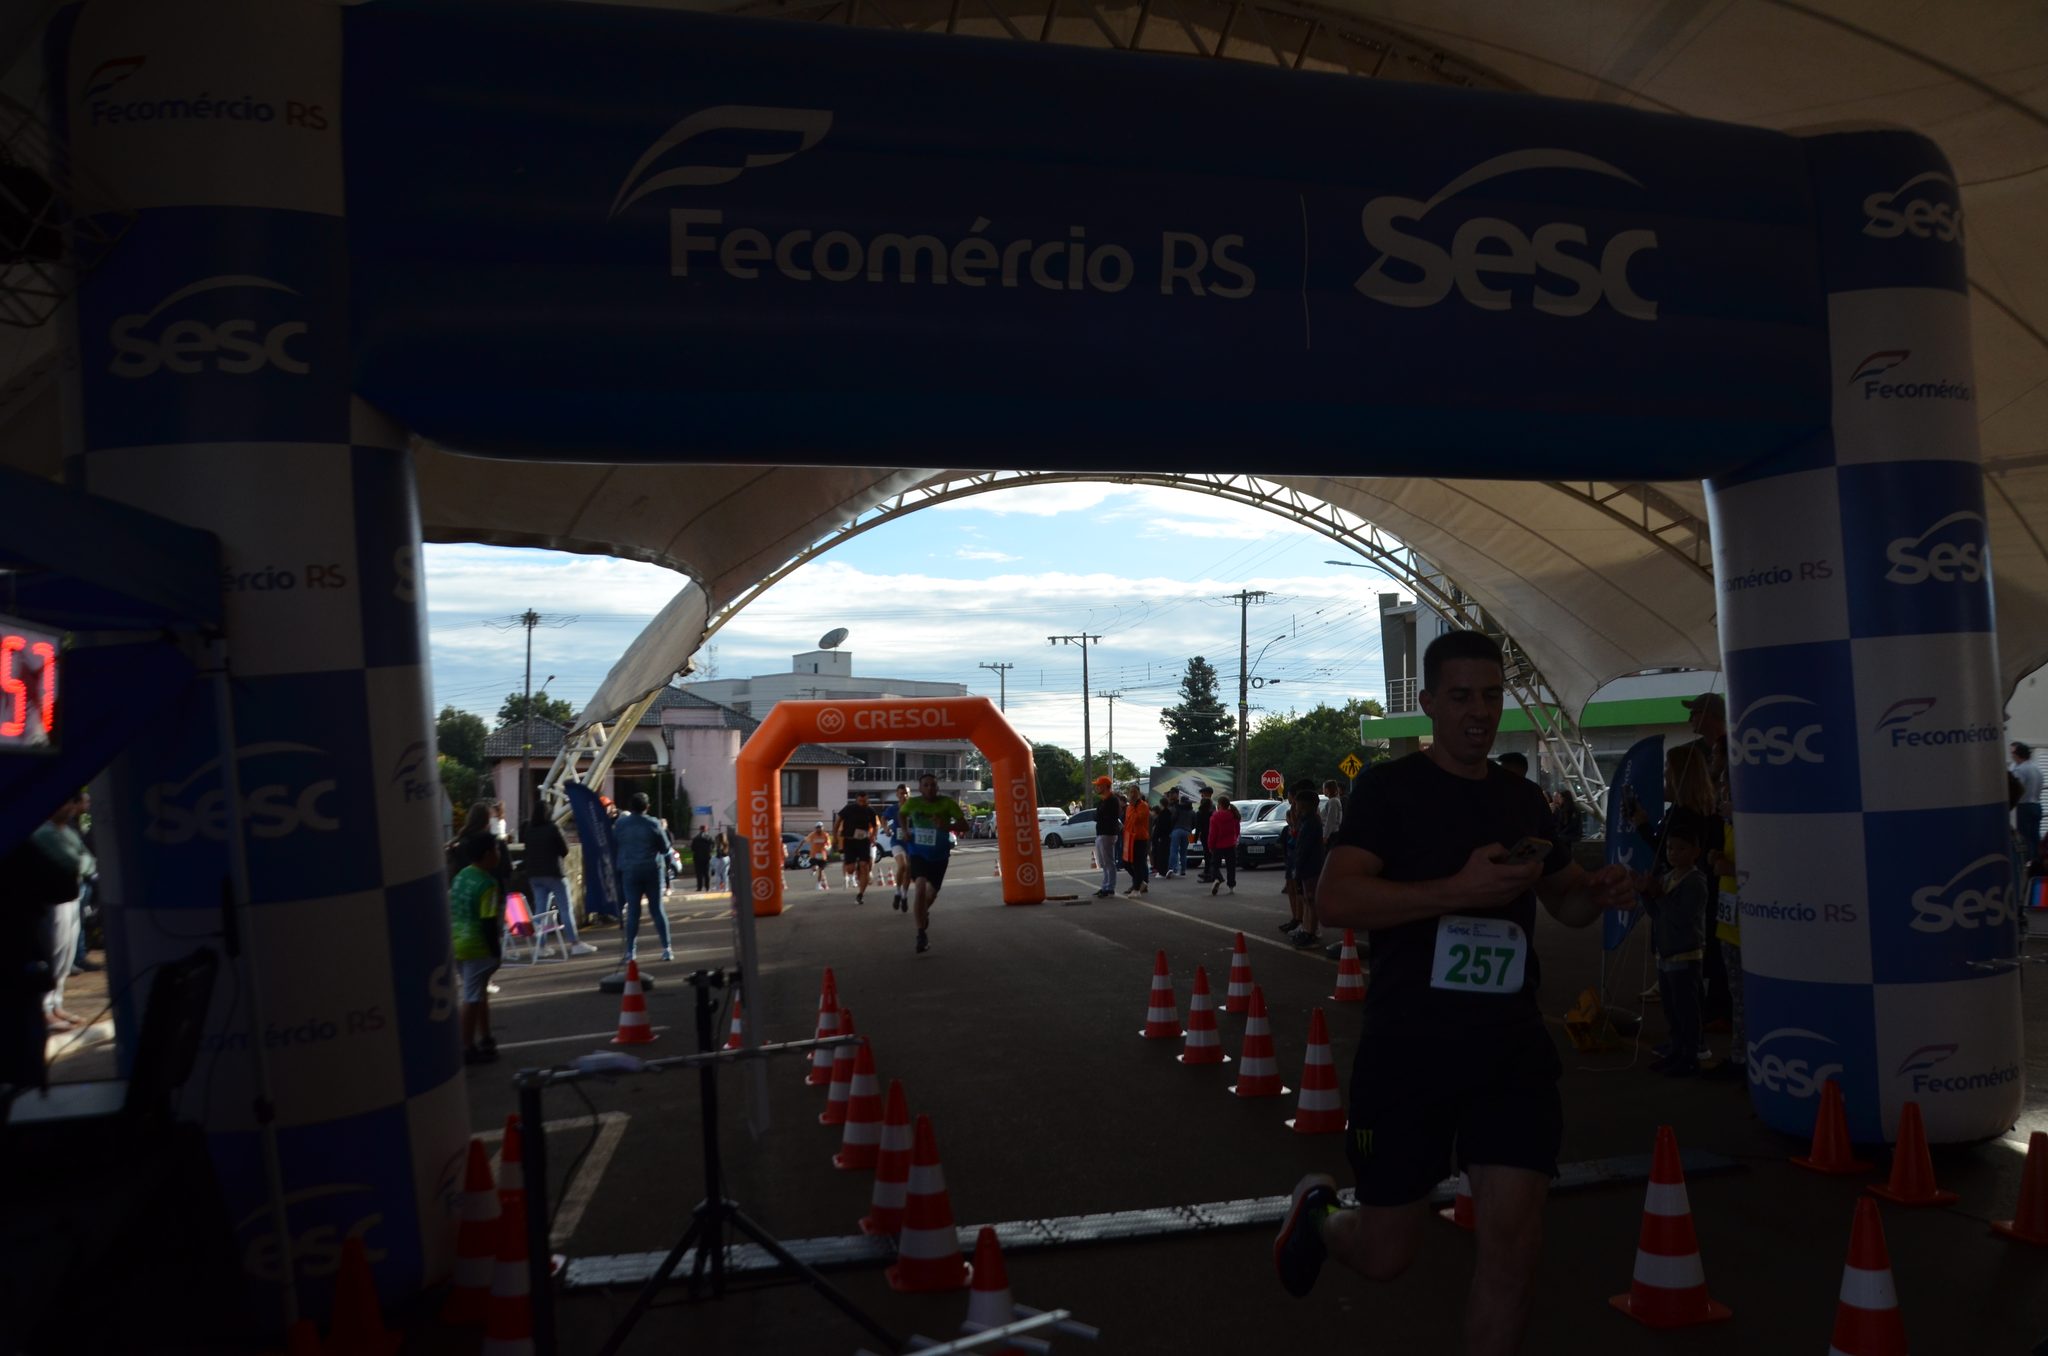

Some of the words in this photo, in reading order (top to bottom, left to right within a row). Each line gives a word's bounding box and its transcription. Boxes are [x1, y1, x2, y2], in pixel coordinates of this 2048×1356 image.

[91, 93, 274, 127] Fecomércio
[286, 102, 329, 131] RS
[669, 207, 1135, 293] Fecomércio
[1160, 230, 1256, 299] RS
[1353, 195, 1659, 321] Sesc
[108, 312, 311, 379] Sesc
[305, 564, 346, 589] RS
[1800, 560, 1833, 581] RS
[854, 707, 956, 730] CRESOL
[1262, 776, 1280, 784] PARE
[751, 783, 769, 870] CRESOL
[1012, 772, 1033, 857] CRESOL
[1824, 904, 1857, 922] RS
[1444, 944, 1516, 986] 257
[347, 1007, 386, 1035] RS
